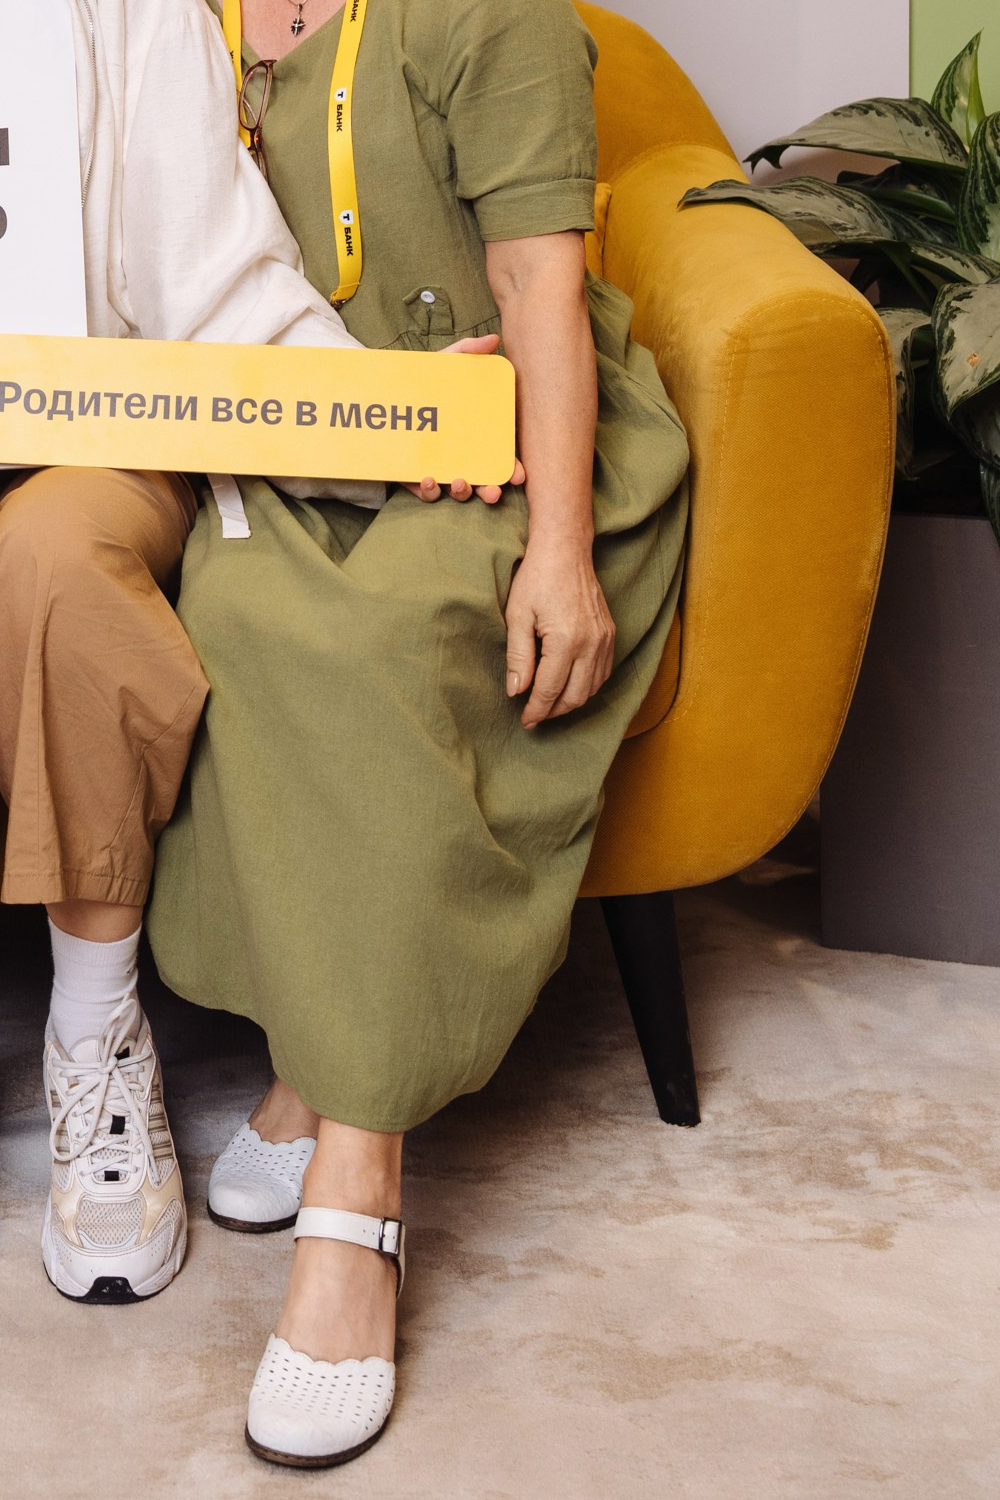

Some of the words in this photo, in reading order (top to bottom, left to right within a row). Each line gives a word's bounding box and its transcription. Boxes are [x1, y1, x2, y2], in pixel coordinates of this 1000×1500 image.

[343, 226, 354, 257] БАНК
[211, 396, 283, 426] все
[295, 400, 318, 427] в
[329, 402, 439, 433] меня
